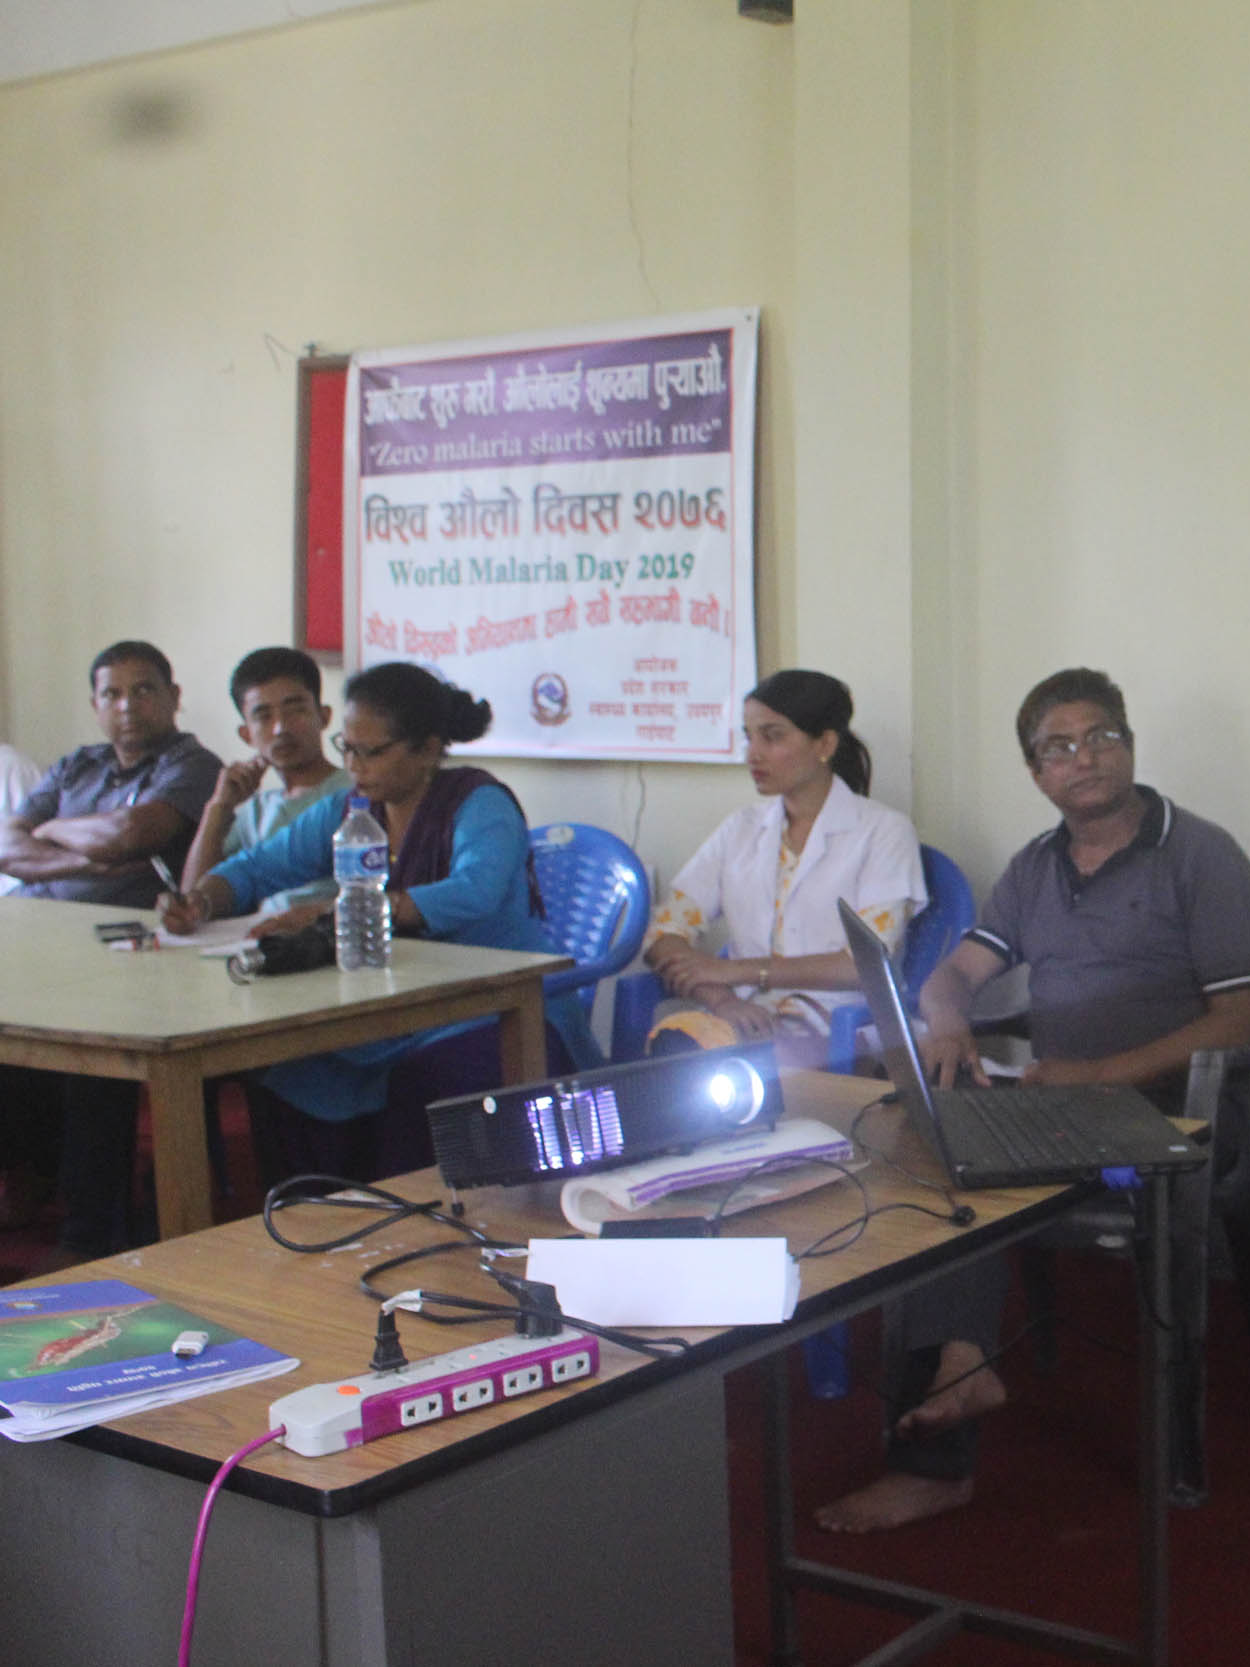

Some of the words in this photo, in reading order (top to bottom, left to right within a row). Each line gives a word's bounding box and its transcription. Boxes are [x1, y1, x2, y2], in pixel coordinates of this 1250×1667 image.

[433, 431, 522, 463] malaria
[528, 426, 596, 459] starts
[602, 418, 662, 450] with
[364, 494, 430, 545] विश्व
[439, 488, 522, 540] औलो
[532, 483, 622, 536] दिवस
[633, 487, 727, 533] २०७६
[388, 556, 462, 588] World
[468, 554, 568, 586] Malaria
[575, 553, 629, 588] Day
[637, 552, 696, 581] 2019
